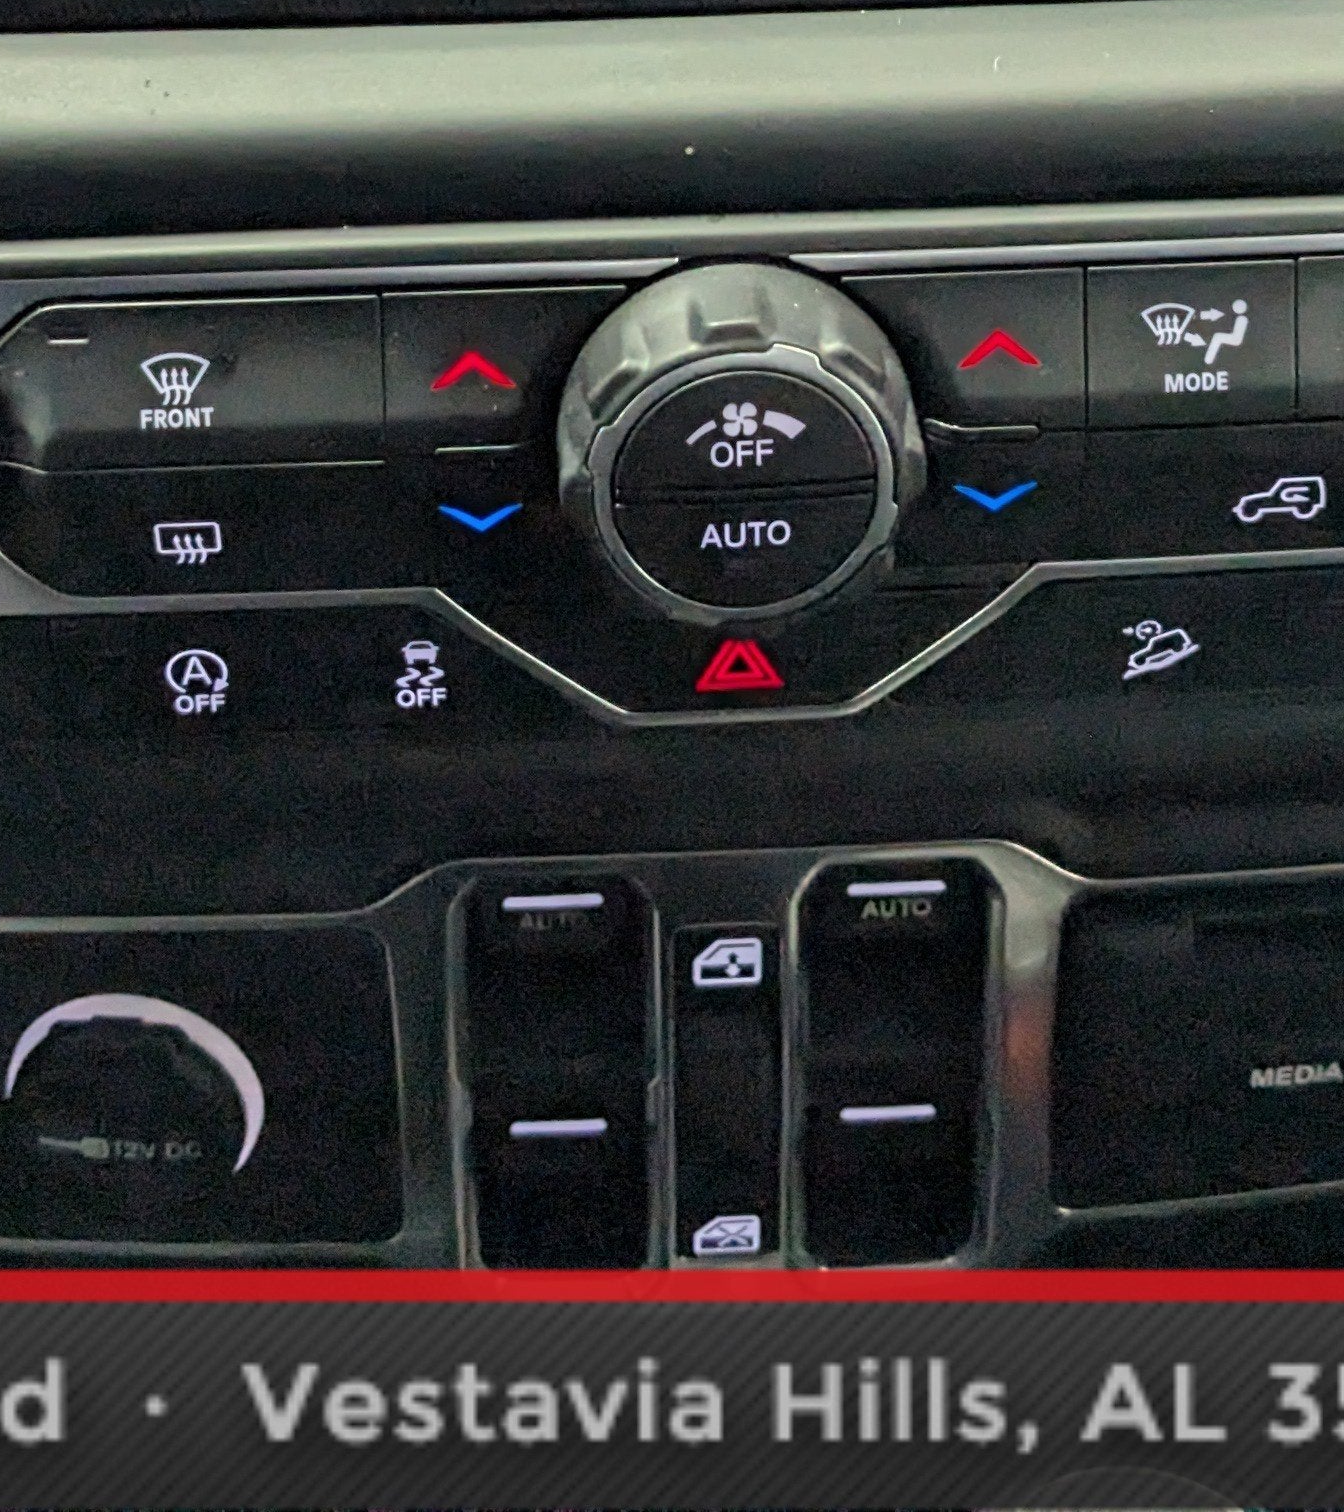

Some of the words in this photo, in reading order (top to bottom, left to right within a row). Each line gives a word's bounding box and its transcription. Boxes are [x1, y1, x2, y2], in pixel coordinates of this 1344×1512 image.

[1164, 371, 1229, 394] MODE
[140, 407, 214, 430] FRONT
[710, 440, 774, 469] OFF
[700, 519, 791, 549] AUTO
[173, 693, 226, 715] OFF
[395, 687, 448, 709] OFF
[861, 897, 932, 921] AUTO
[1251, 1061, 1344, 1088] MEDIA
